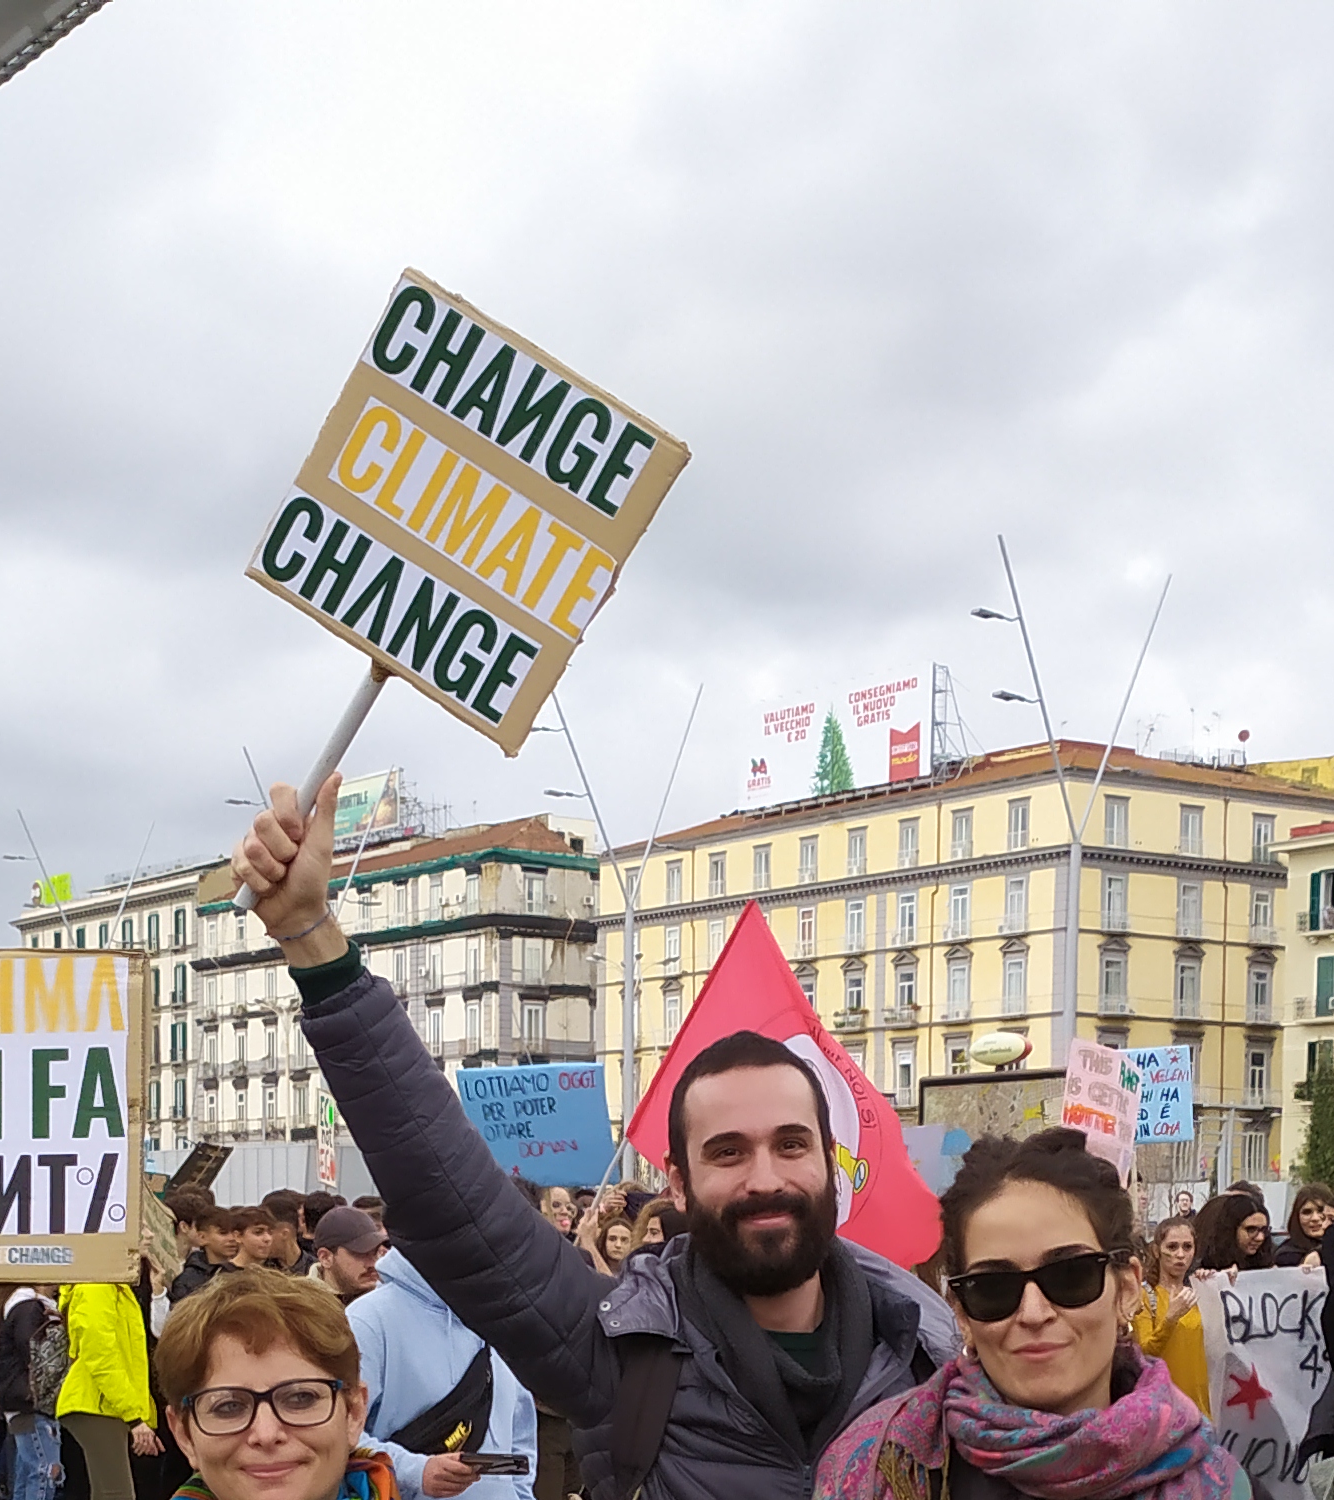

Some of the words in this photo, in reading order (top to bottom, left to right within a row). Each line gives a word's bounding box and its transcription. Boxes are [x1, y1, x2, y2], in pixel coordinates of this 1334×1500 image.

[371, 285, 657, 518] CHANGE
[336, 405, 615, 638] CLIMATE
[261, 496, 540, 725] CHANGE
[848, 676, 918, 705] CONSEGNIAMO
[763, 702, 815, 724] VALUTIAMO
[852, 704, 861, 715] IL
[862, 695, 896, 713] NUOVO
[764, 725, 771, 736] IL
[773, 716, 811, 734] VECCHIO
[856, 709, 891, 727] GRATIS
[794, 729, 806, 742] 20
[1078, 1048, 1113, 1076] THIS
[1135, 1052, 1160, 1070] HA
[463, 1072, 550, 1101] LOTTIAMO
[558, 1069, 596, 1091] OGGI
[844, 1067, 869, 1102] NOI
[1067, 1072, 1082, 1096] IS
[1149, 1067, 1190, 1084] VELENI
[31, 1046, 126, 1139] FA
[1159, 1086, 1180, 1103] HA
[481, 1102, 506, 1121] PER
[513, 1096, 557, 1117] POTER
[1153, 1120, 1181, 1137] COMA
